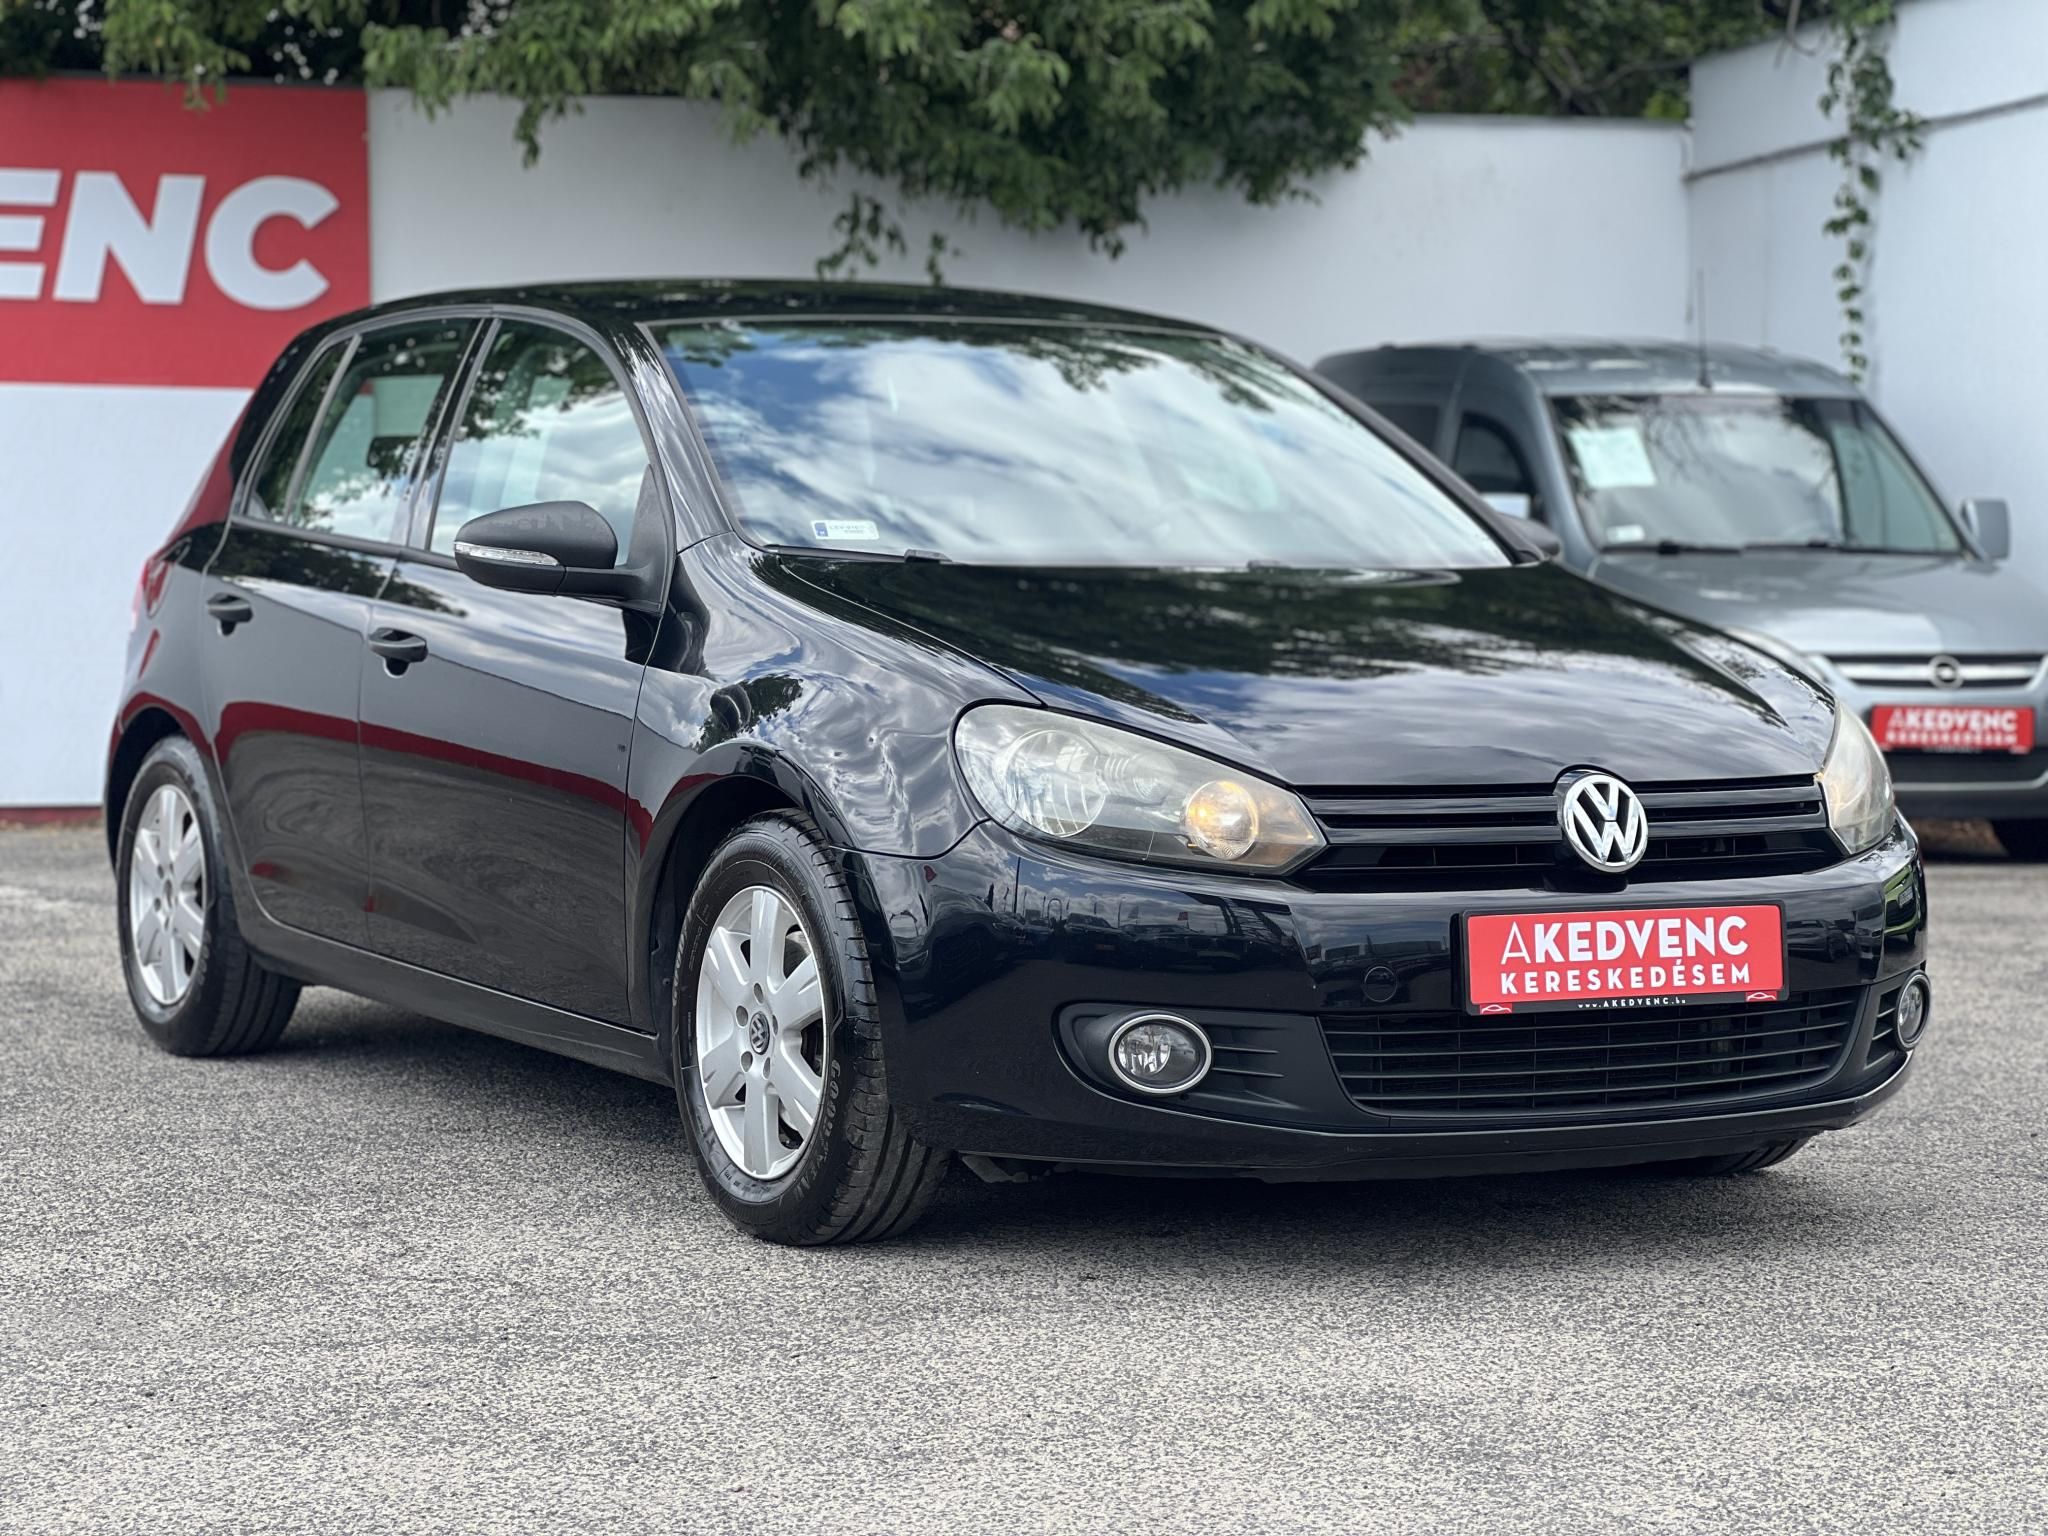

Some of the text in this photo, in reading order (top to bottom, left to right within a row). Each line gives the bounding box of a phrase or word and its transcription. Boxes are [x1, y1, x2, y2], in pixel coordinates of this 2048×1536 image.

[0, 167, 340, 311] ENC
[1500, 915, 1749, 966] AKEDVENC
[1500, 959, 1750, 996] KERESKEDÉSEM
